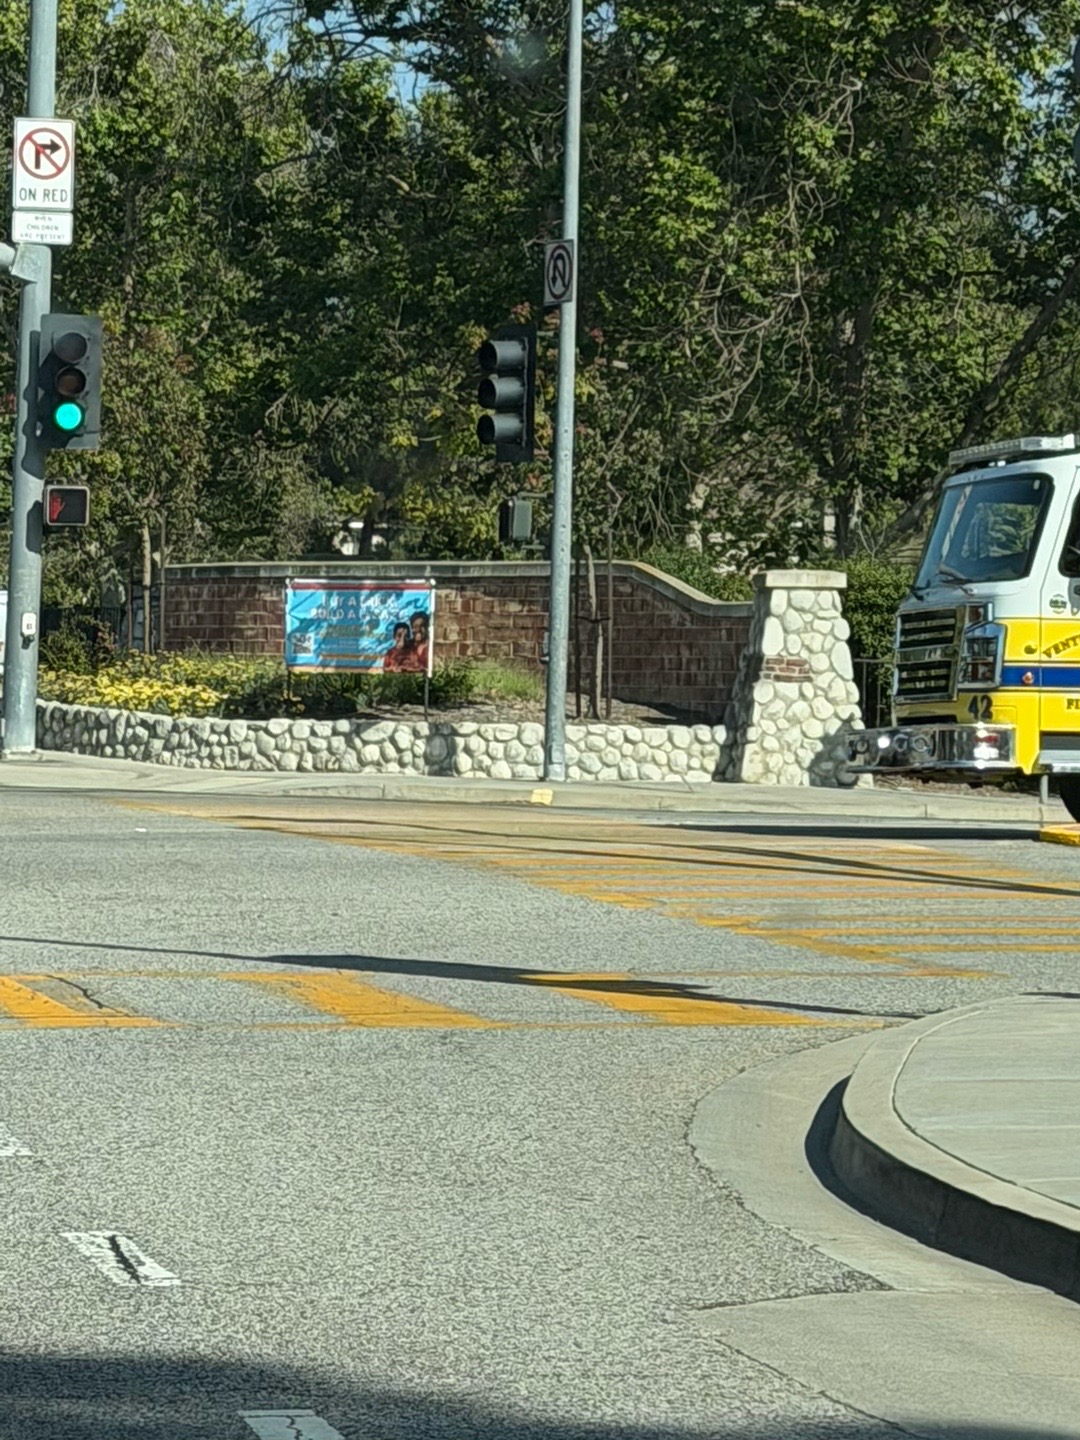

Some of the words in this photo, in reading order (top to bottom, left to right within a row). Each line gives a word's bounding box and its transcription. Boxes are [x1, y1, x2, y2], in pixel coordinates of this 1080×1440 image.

[19, 187, 37, 202] ON
[42, 188, 68, 203] RED
[968, 694, 994, 721] 42
